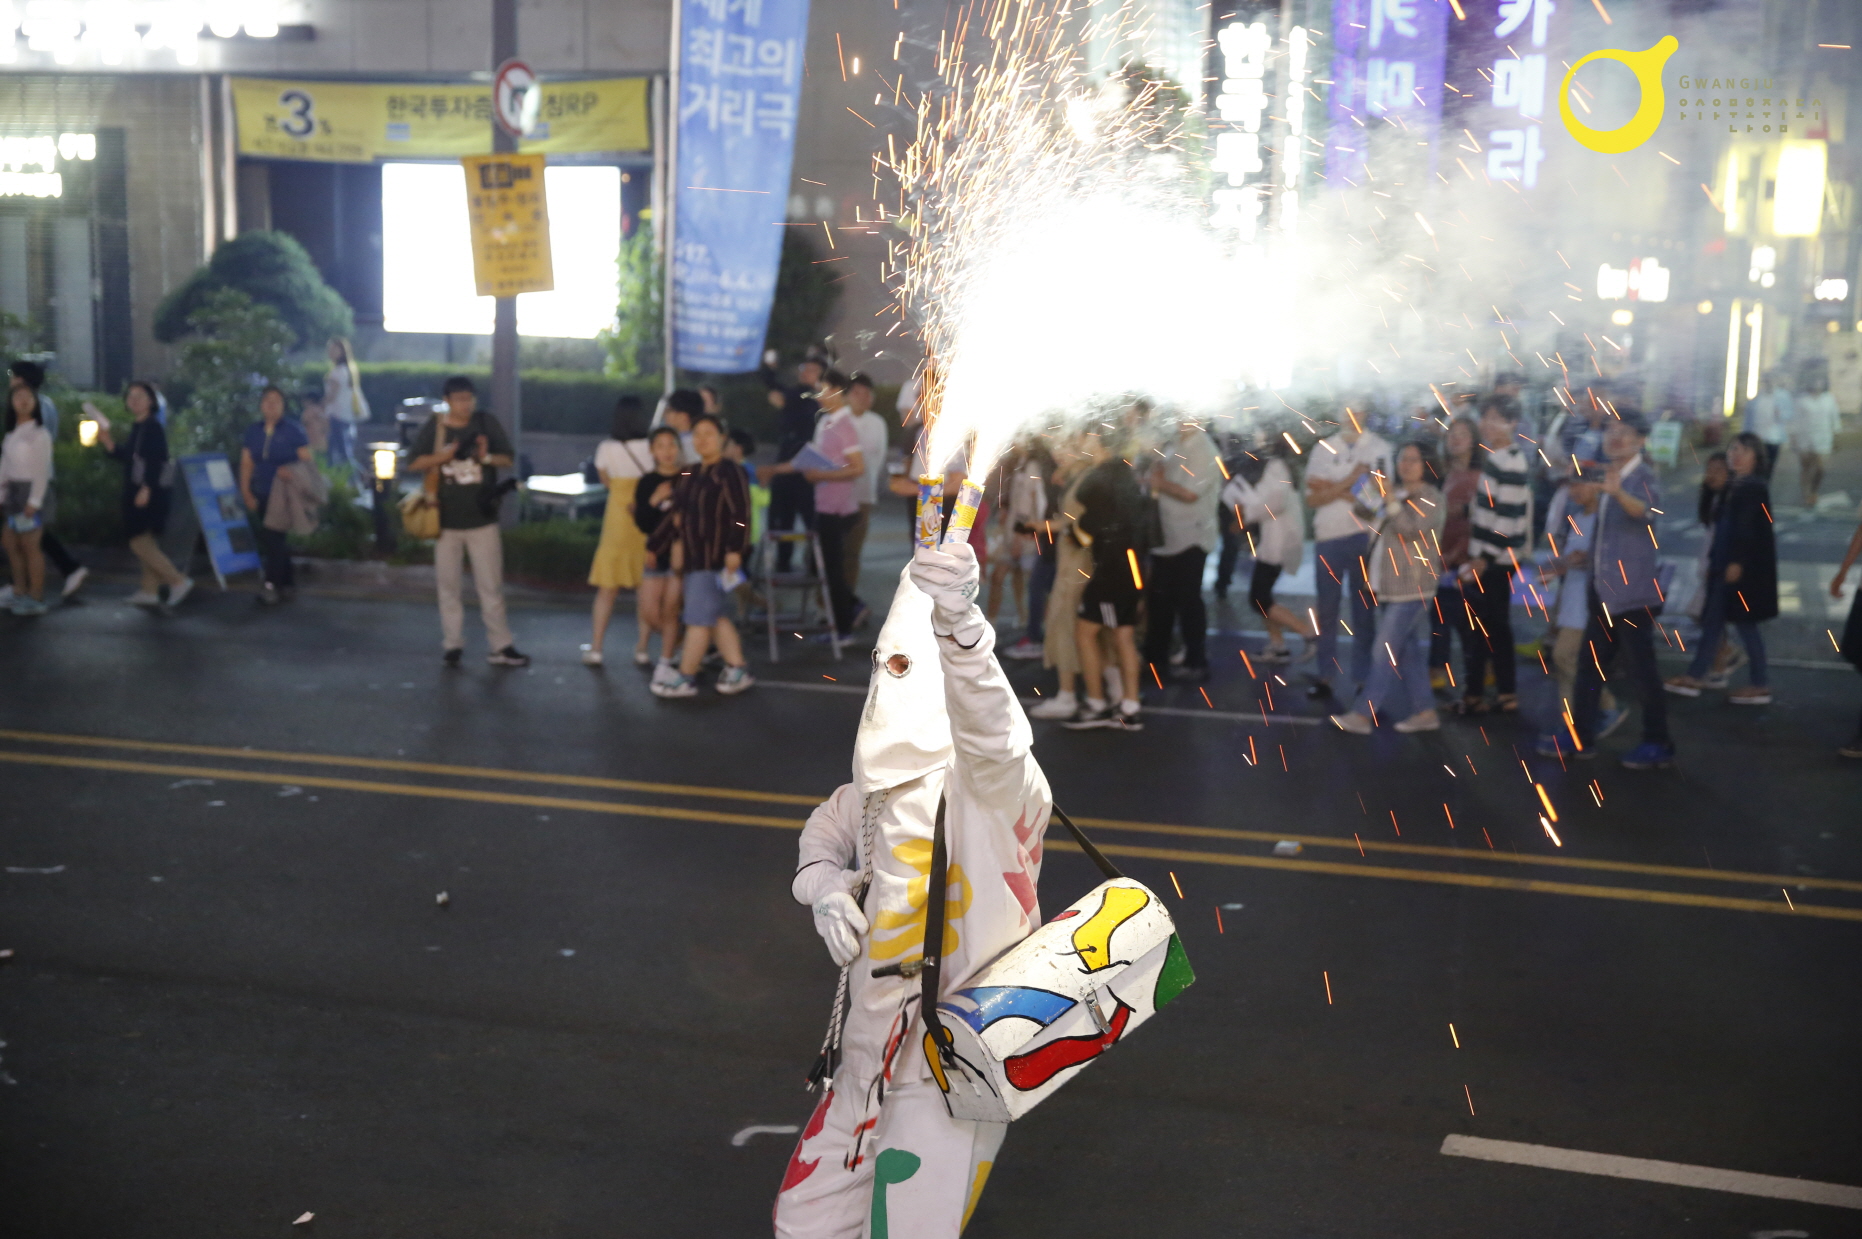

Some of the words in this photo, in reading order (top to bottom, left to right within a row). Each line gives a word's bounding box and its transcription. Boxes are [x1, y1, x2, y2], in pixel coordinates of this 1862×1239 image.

[689, 28, 796, 86] 최고의
[386, 94, 495, 121] 한국투자증
[680, 83, 795, 139] 거리극
